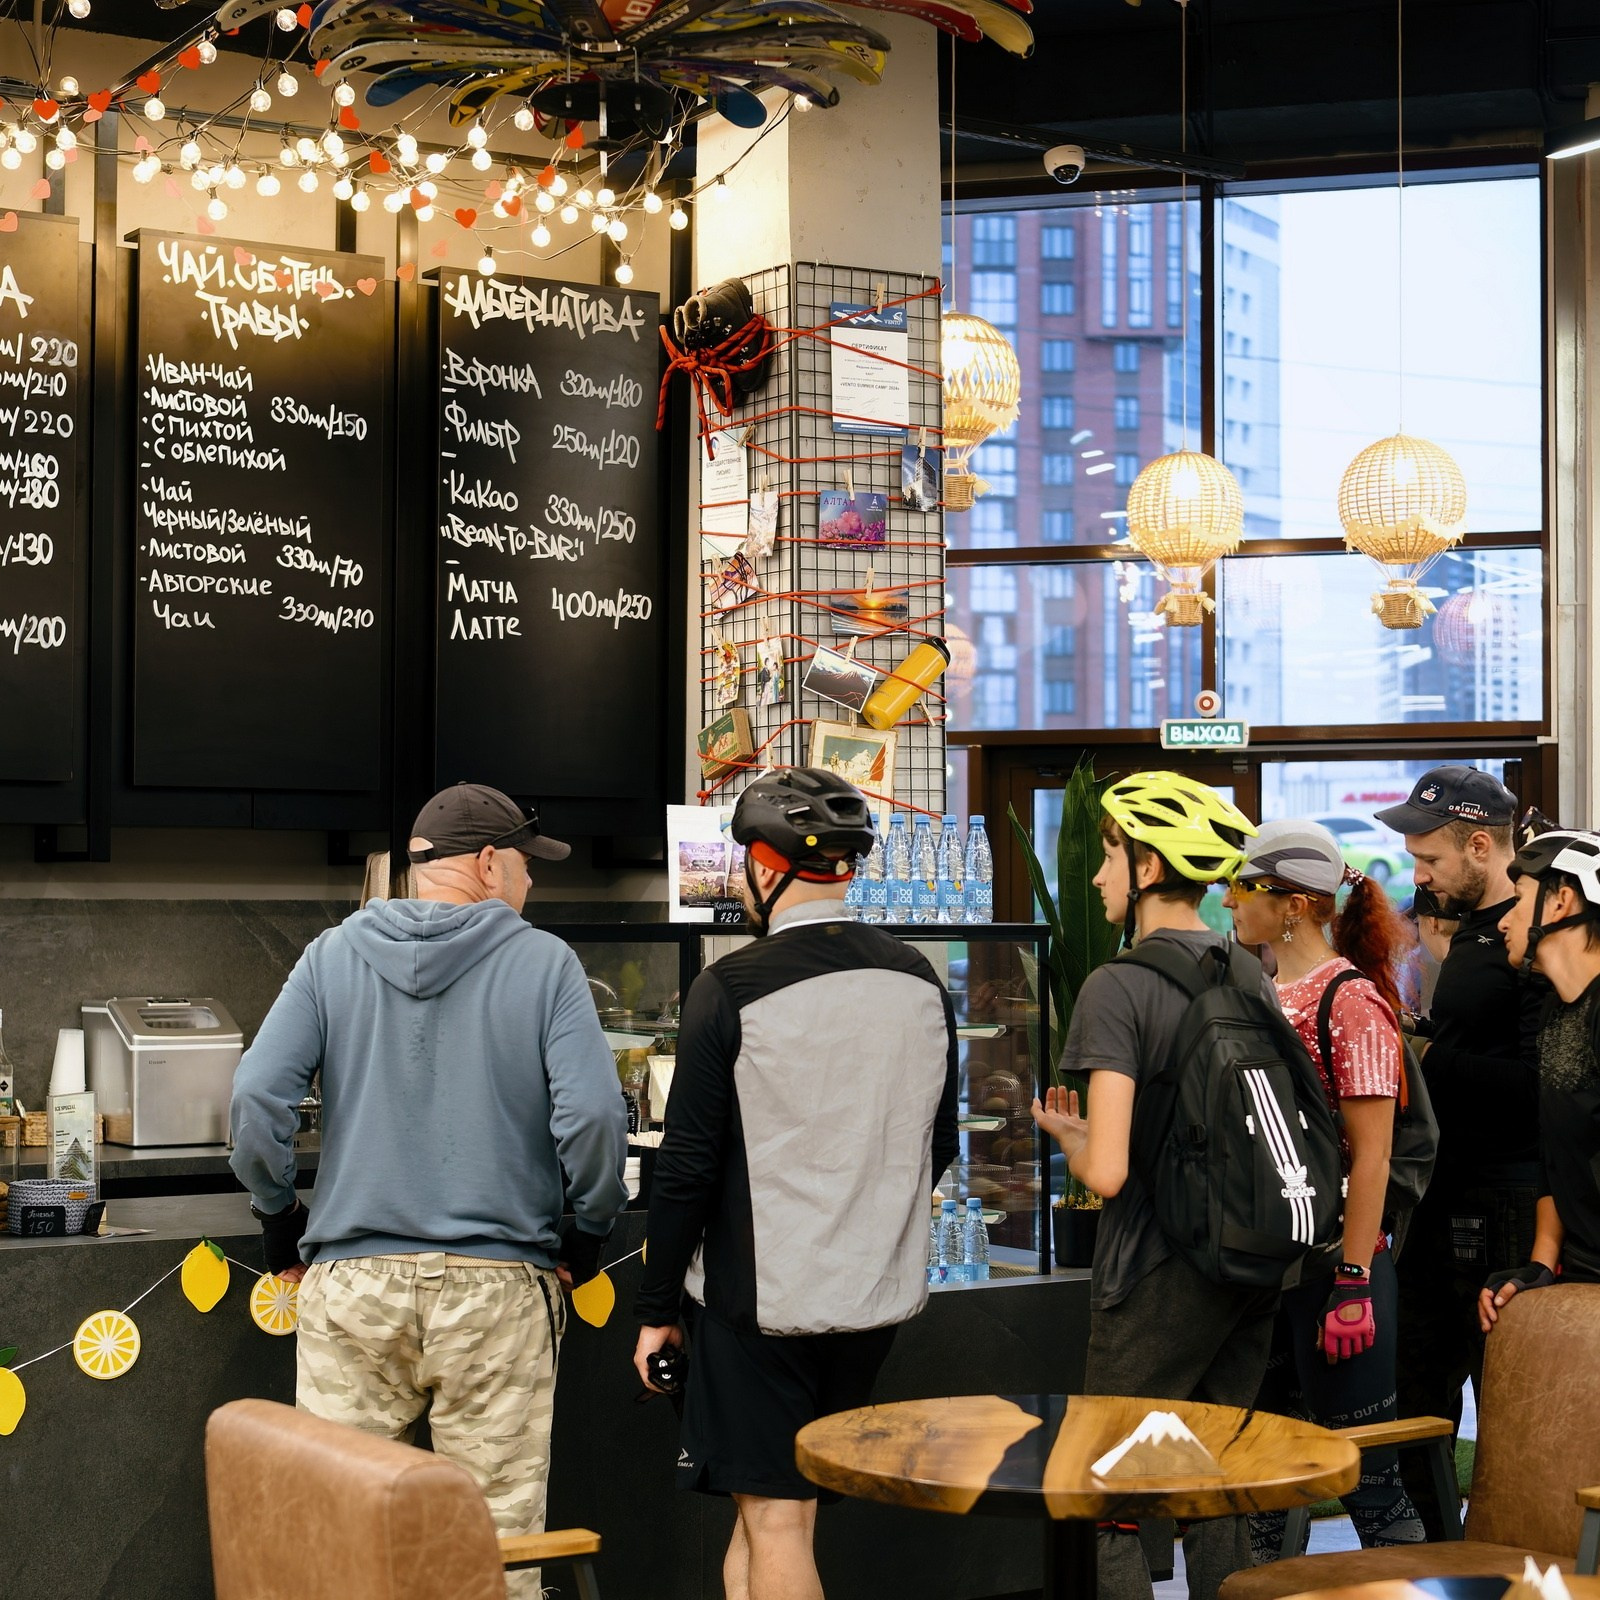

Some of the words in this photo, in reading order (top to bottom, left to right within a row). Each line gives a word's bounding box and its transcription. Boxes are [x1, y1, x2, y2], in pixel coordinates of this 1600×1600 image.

[24, 409, 74, 438] 220
[1170, 725, 1241, 743] ВЫХОД
[1448, 804, 1489, 817] ORIGINAL
[1280, 1186, 1317, 1198] adidas
[28, 1220, 55, 1234] 150
[1352, 1402, 1380, 1420] OUT
